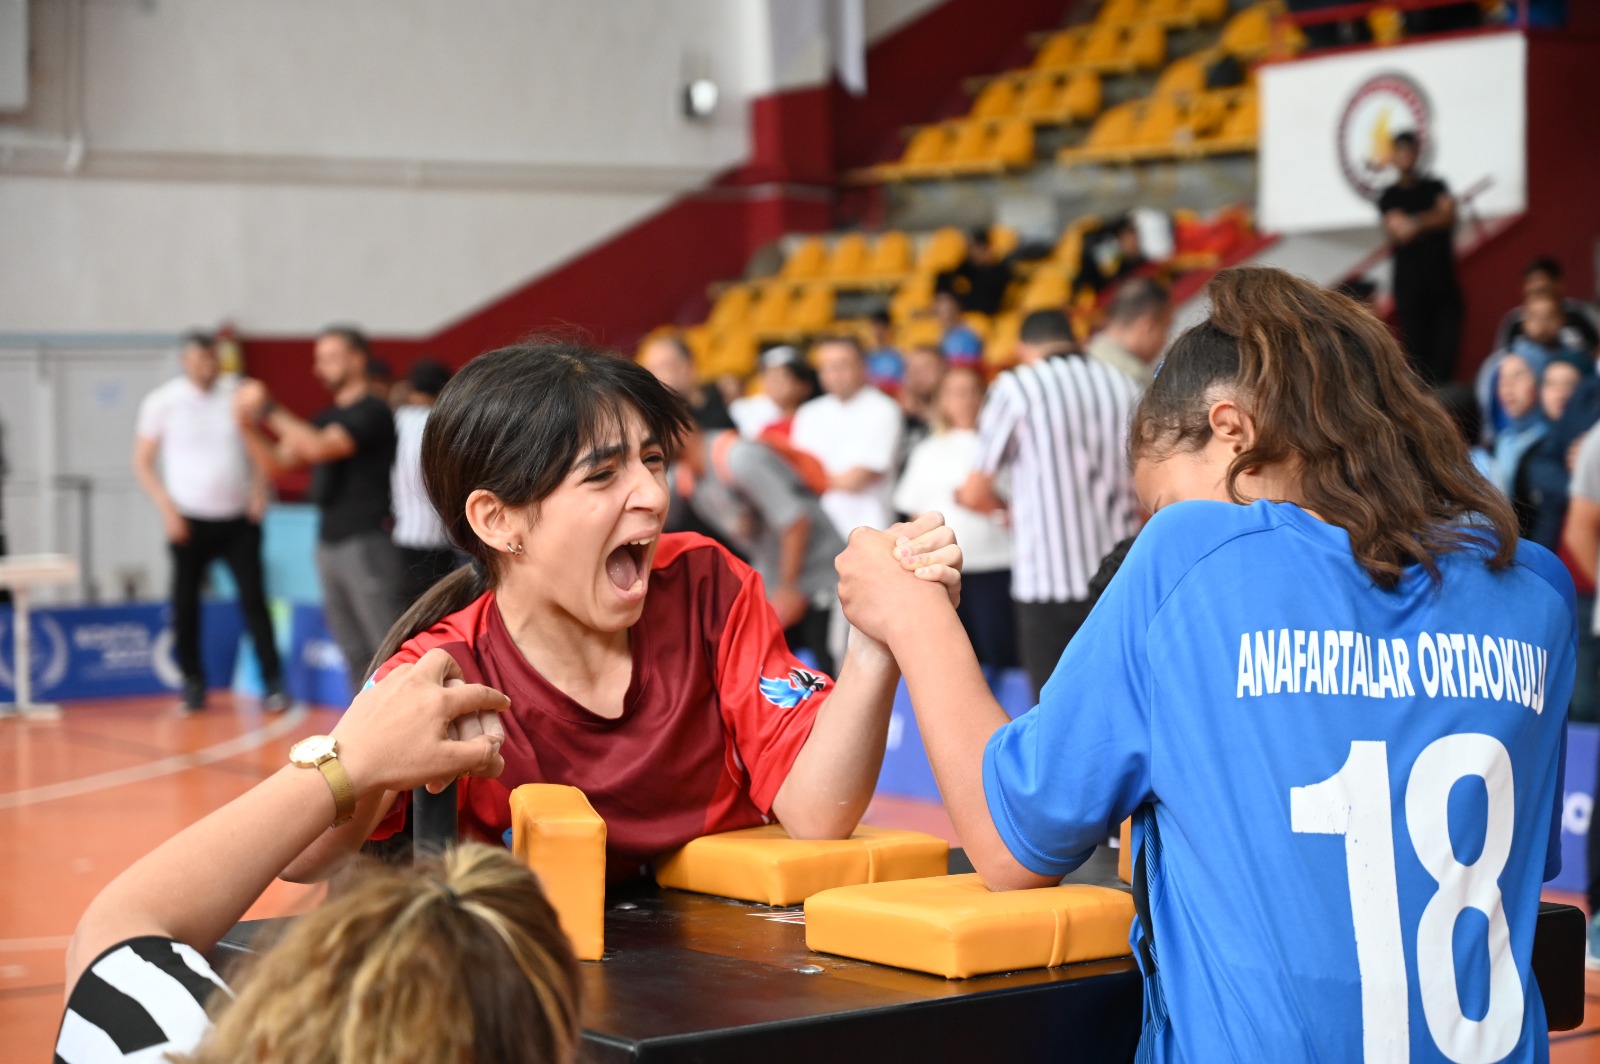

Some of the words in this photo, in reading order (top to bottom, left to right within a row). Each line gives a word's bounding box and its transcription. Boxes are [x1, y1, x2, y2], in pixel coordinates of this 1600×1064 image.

[1237, 629, 1415, 698] ANAFARTALAR
[1417, 631, 1547, 715] ORTAOKULU
[1290, 733, 1524, 1064] 18
